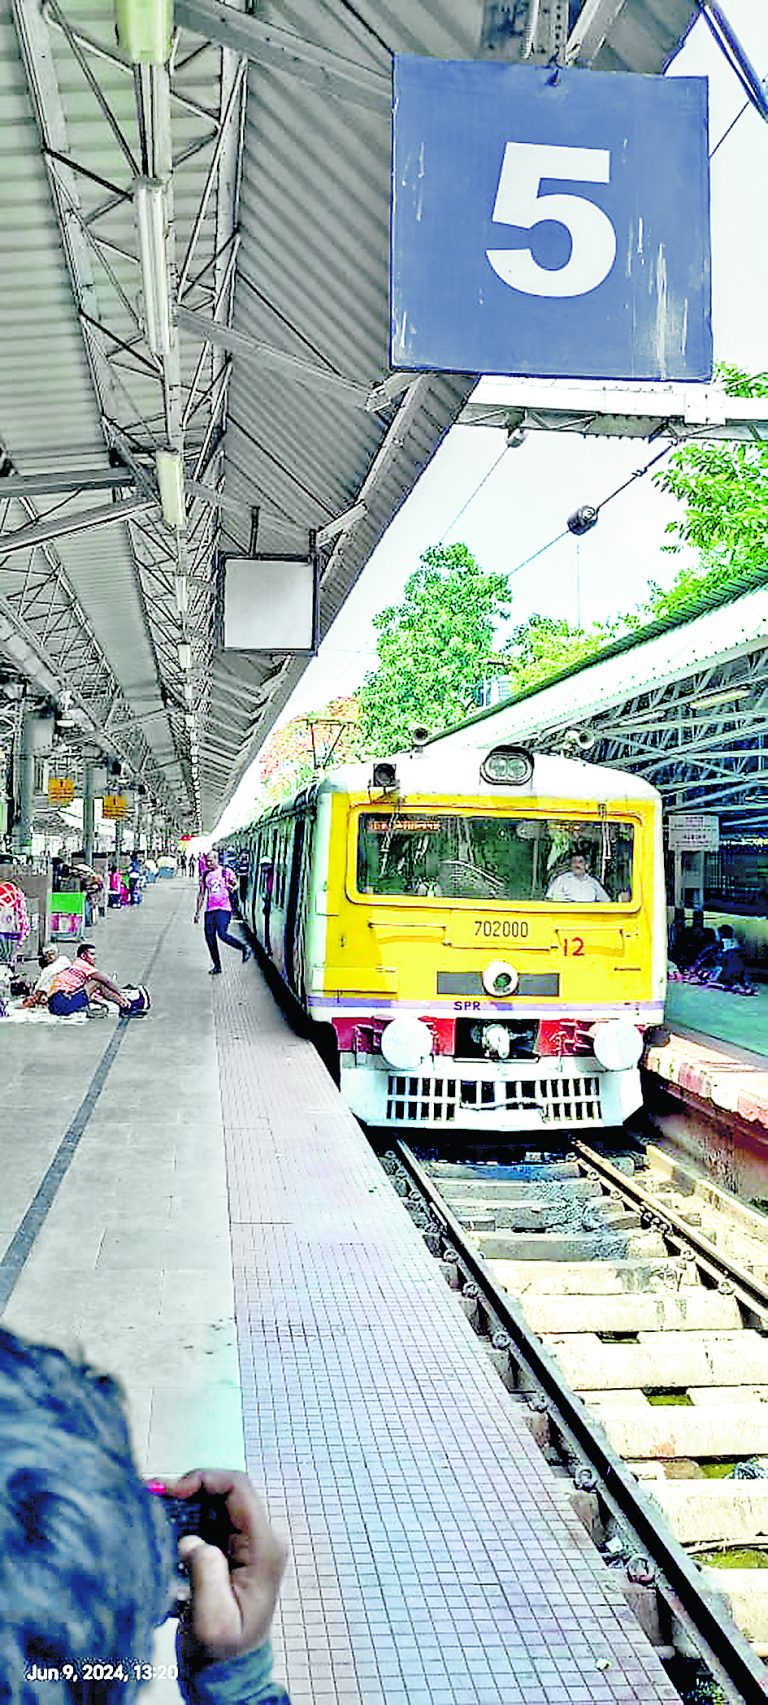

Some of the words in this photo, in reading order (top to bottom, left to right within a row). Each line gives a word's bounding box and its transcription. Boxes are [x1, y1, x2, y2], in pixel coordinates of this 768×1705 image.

[485, 141, 617, 298] 5
[474, 920, 529, 937] 702000
[562, 936, 585, 956] 12
[453, 1000, 481, 1011] SPR
